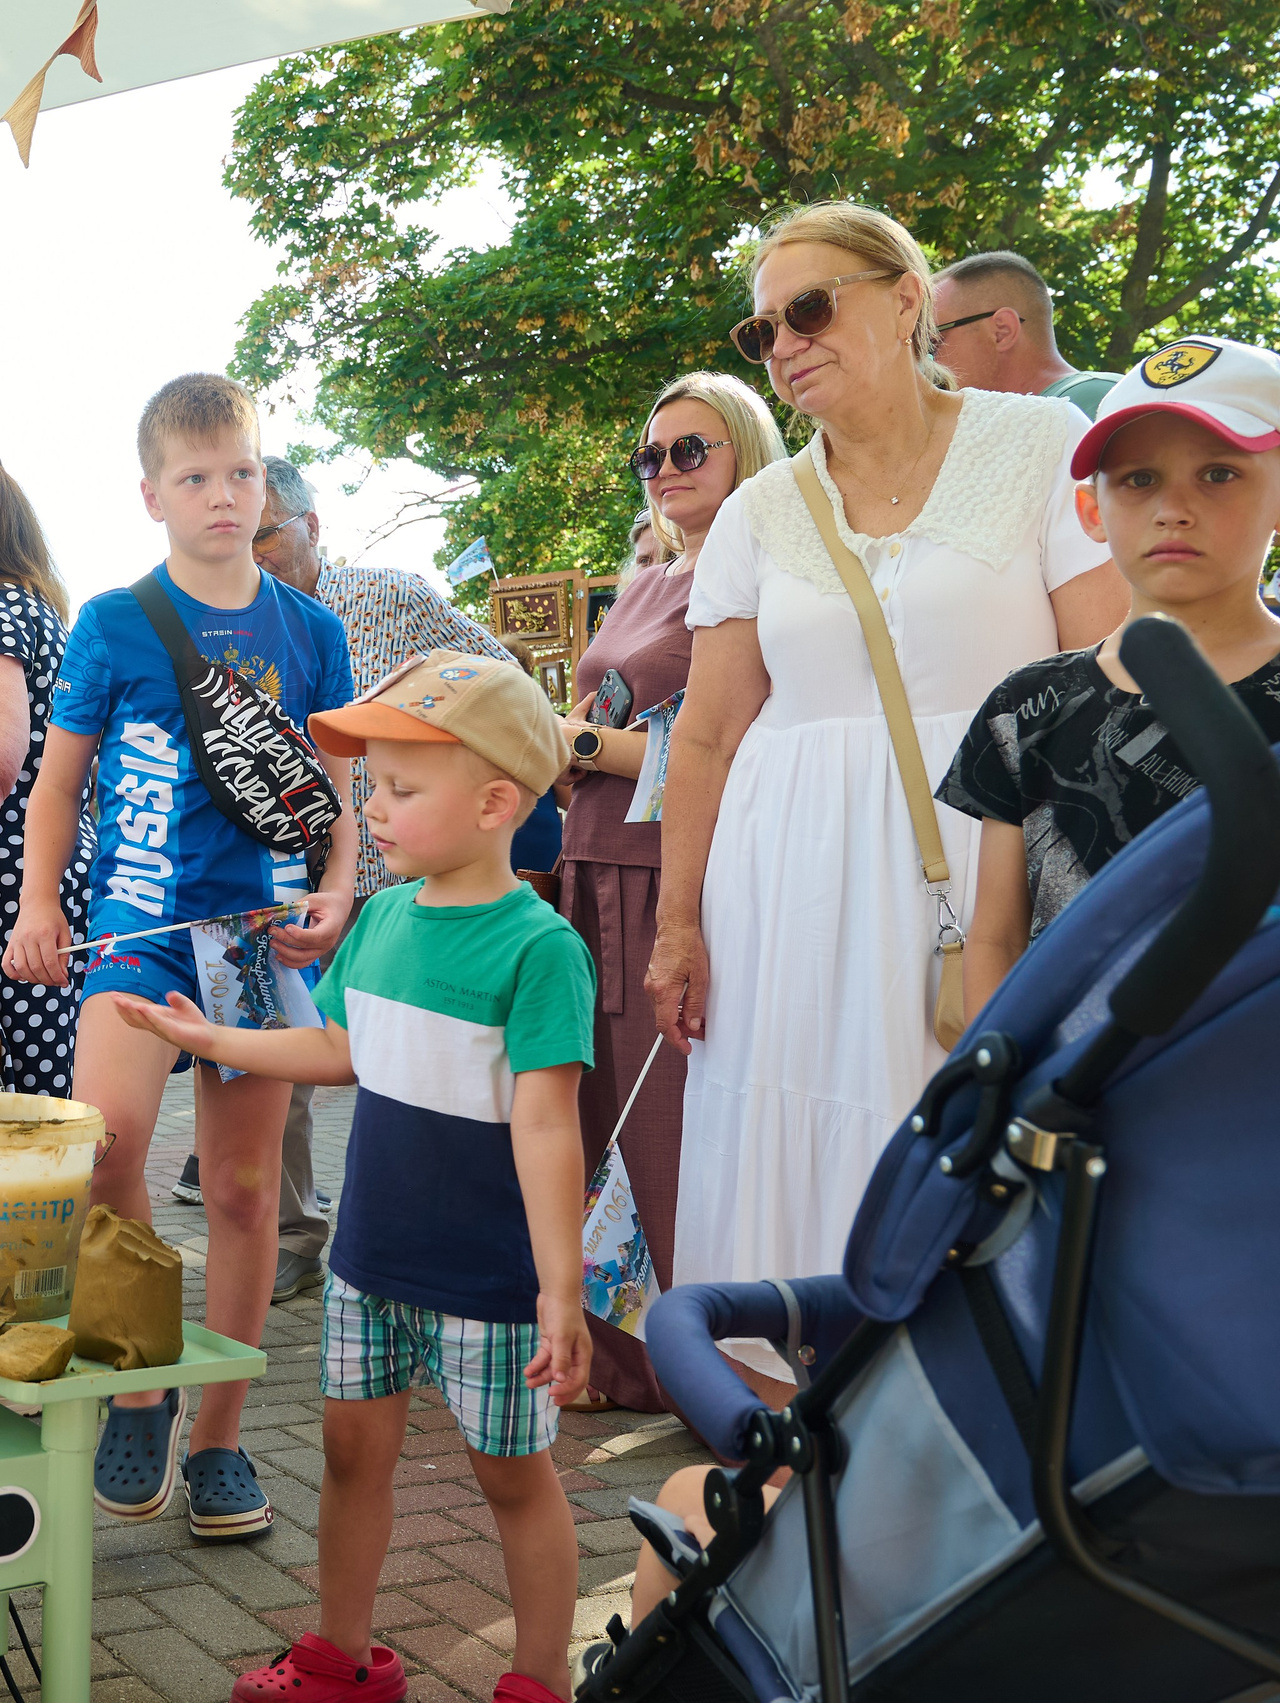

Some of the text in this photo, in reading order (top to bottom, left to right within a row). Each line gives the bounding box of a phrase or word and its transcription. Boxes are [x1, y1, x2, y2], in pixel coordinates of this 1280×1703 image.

[1135, 753, 1167, 780] ALL
[104, 722, 179, 918] RUSSIA
[205, 959, 230, 999] 190
[423, 978, 501, 1003] ASTON MARTIN
[603, 1177, 631, 1223] 190
